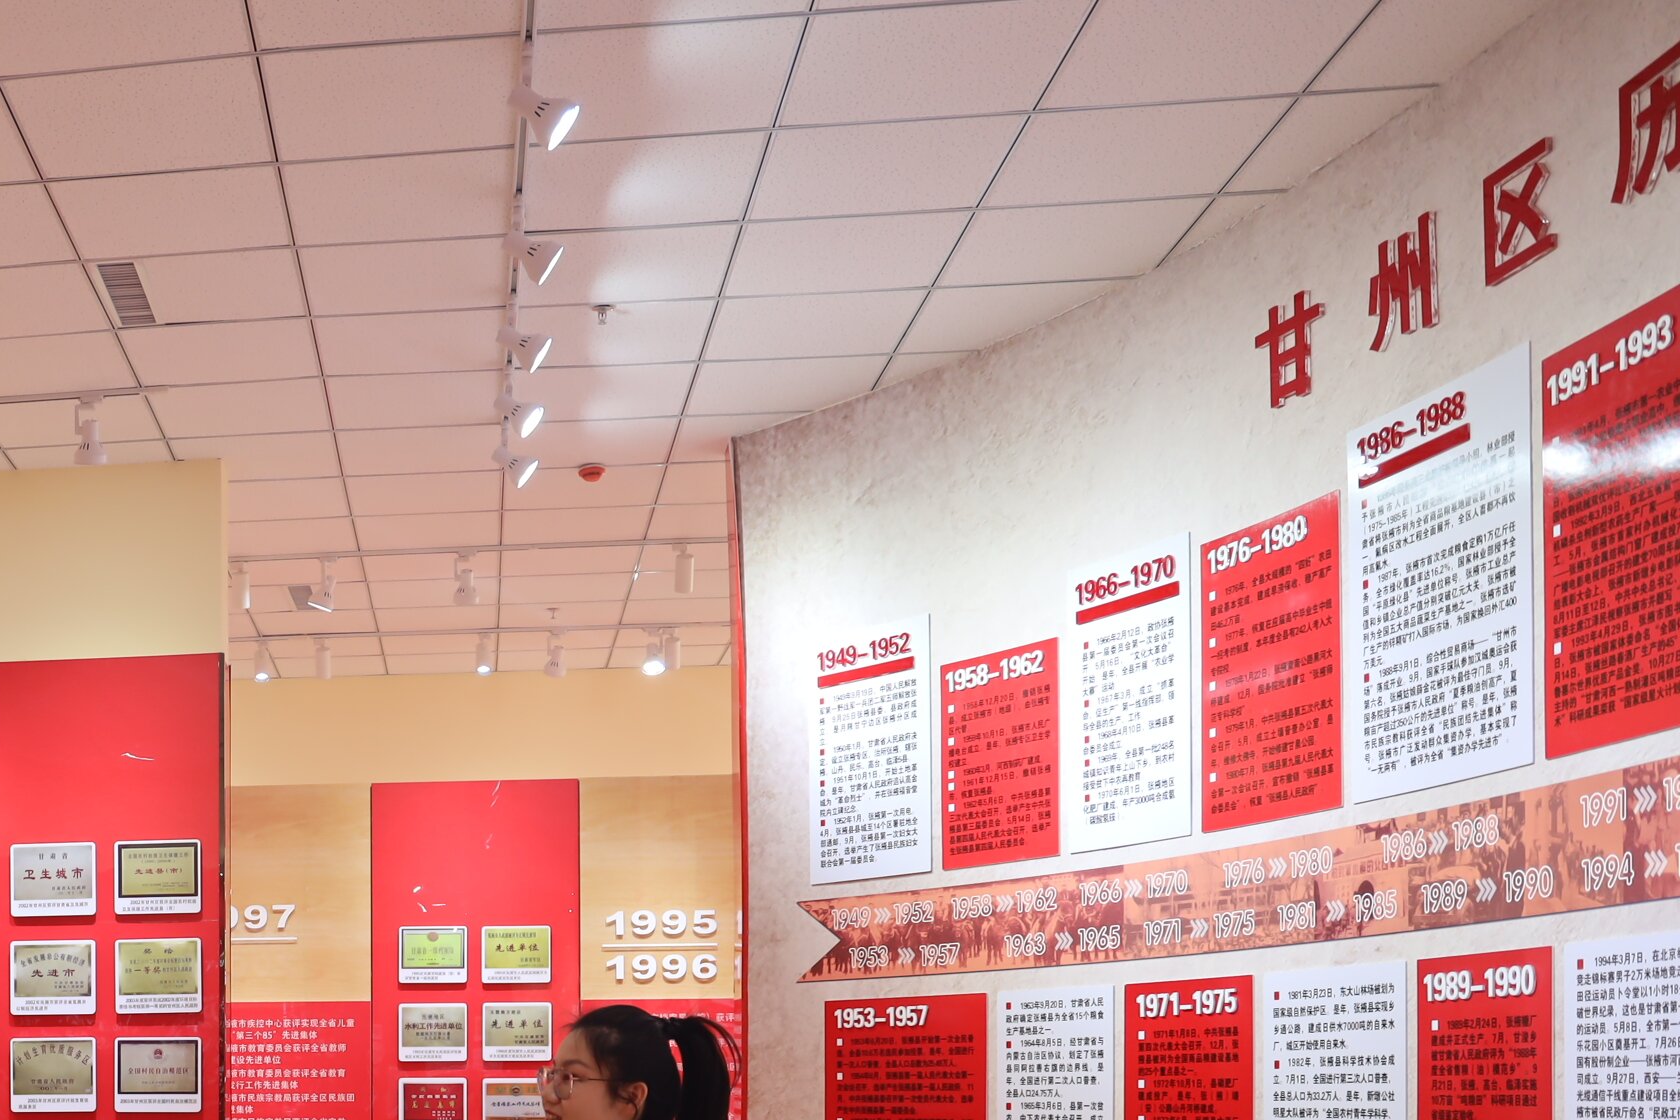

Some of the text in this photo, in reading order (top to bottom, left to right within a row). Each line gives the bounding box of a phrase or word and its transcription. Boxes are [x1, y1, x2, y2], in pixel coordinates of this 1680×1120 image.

[1580, 787, 1628, 828] 1991
[1381, 829, 1427, 863] 1986
[1452, 814, 1500, 851] 1988
[23, 867, 84, 881] 卫生城市
[1222, 857, 1265, 888] 1976
[1289, 845, 1334, 878] 1980
[1581, 851, 1635, 892] 1994
[1080, 879, 1123, 906] 1966
[1146, 869, 1190, 898] 1970
[1421, 879, 1468, 914] 1989
[1503, 866, 1554, 903] 1990
[894, 901, 934, 925] 1952
[951, 894, 992, 920] 1958
[1016, 887, 1058, 913] 1962
[1353, 889, 1398, 922] 1985
[606, 909, 718, 936] 1995
[832, 906, 873, 930] 1949
[1213, 909, 1255, 938] 1975
[1277, 900, 1317, 931] 1981
[1005, 932, 1047, 957] 1963
[1078, 925, 1122, 951] 1965
[1144, 918, 1184, 945] 1971
[606, 953, 718, 981] 1996
[849, 946, 889, 968] 1953
[919, 943, 960, 966] 1957
[31, 968, 76, 979] 先进市
